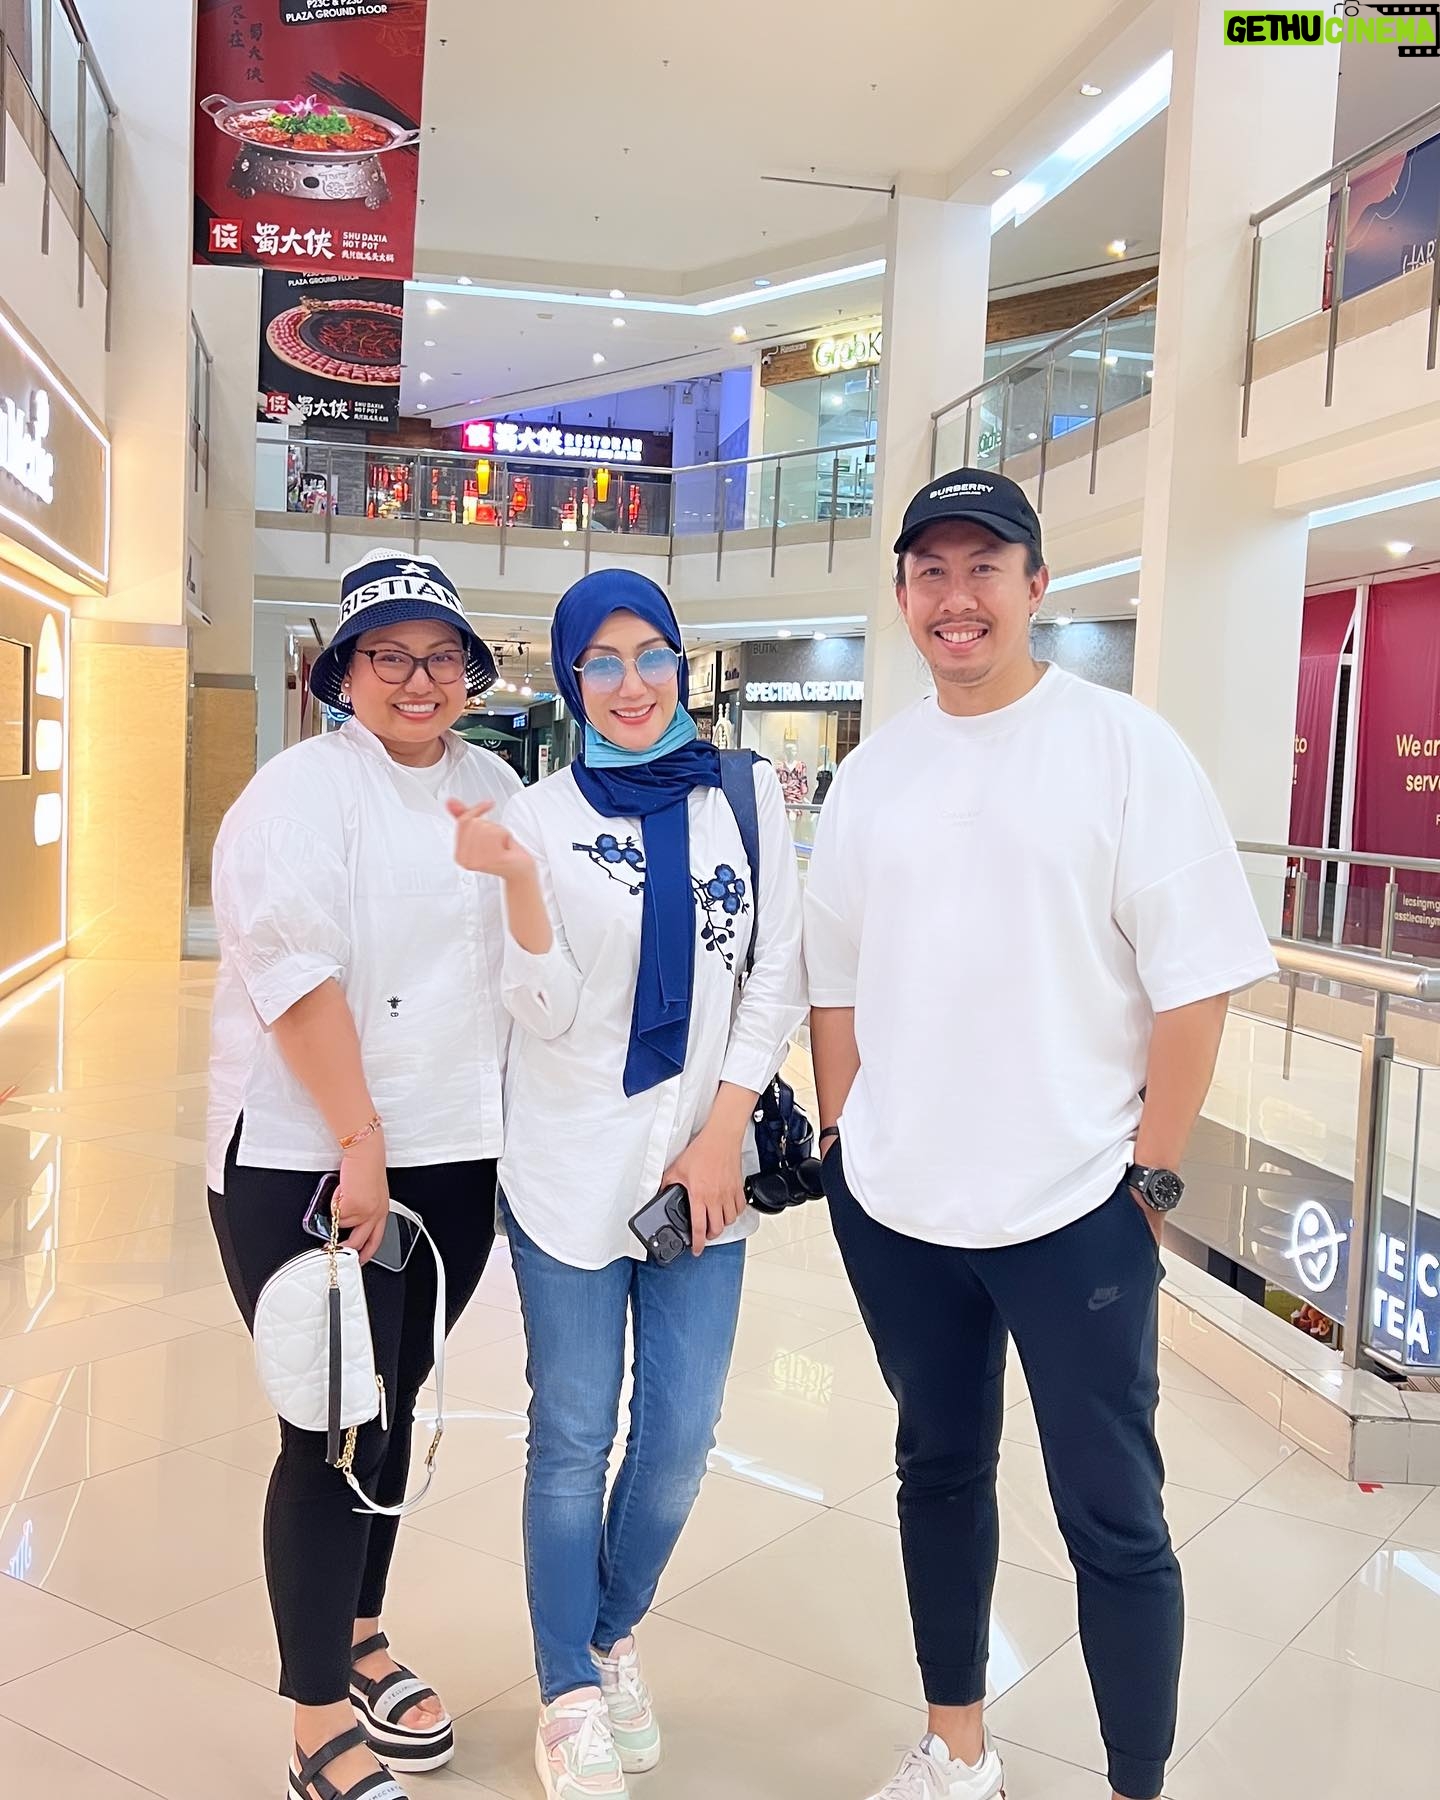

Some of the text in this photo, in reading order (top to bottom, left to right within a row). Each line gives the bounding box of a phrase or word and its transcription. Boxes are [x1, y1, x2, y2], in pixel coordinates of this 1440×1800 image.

[286, 5, 388, 22] PLAZA GROUND FLOOR
[251, 221, 336, 260] 蜀大侠
[342, 240, 379, 251] HOT POT
[343, 231, 388, 243] SHU DAXIA
[288, 279, 308, 287] PLAZA
[308, 276, 338, 285] GROUND
[780, 343, 807, 354] Restoran
[295, 395, 350, 420] 蜀大侠
[564, 433, 643, 452] RESTORAN
[930, 483, 994, 499] BURBERRY
[753, 643, 777, 655] BUTIK
[745, 681, 804, 702] SPECTRA
[1396, 734, 1421, 757] We
[1373, 1287, 1430, 1355] TEA
